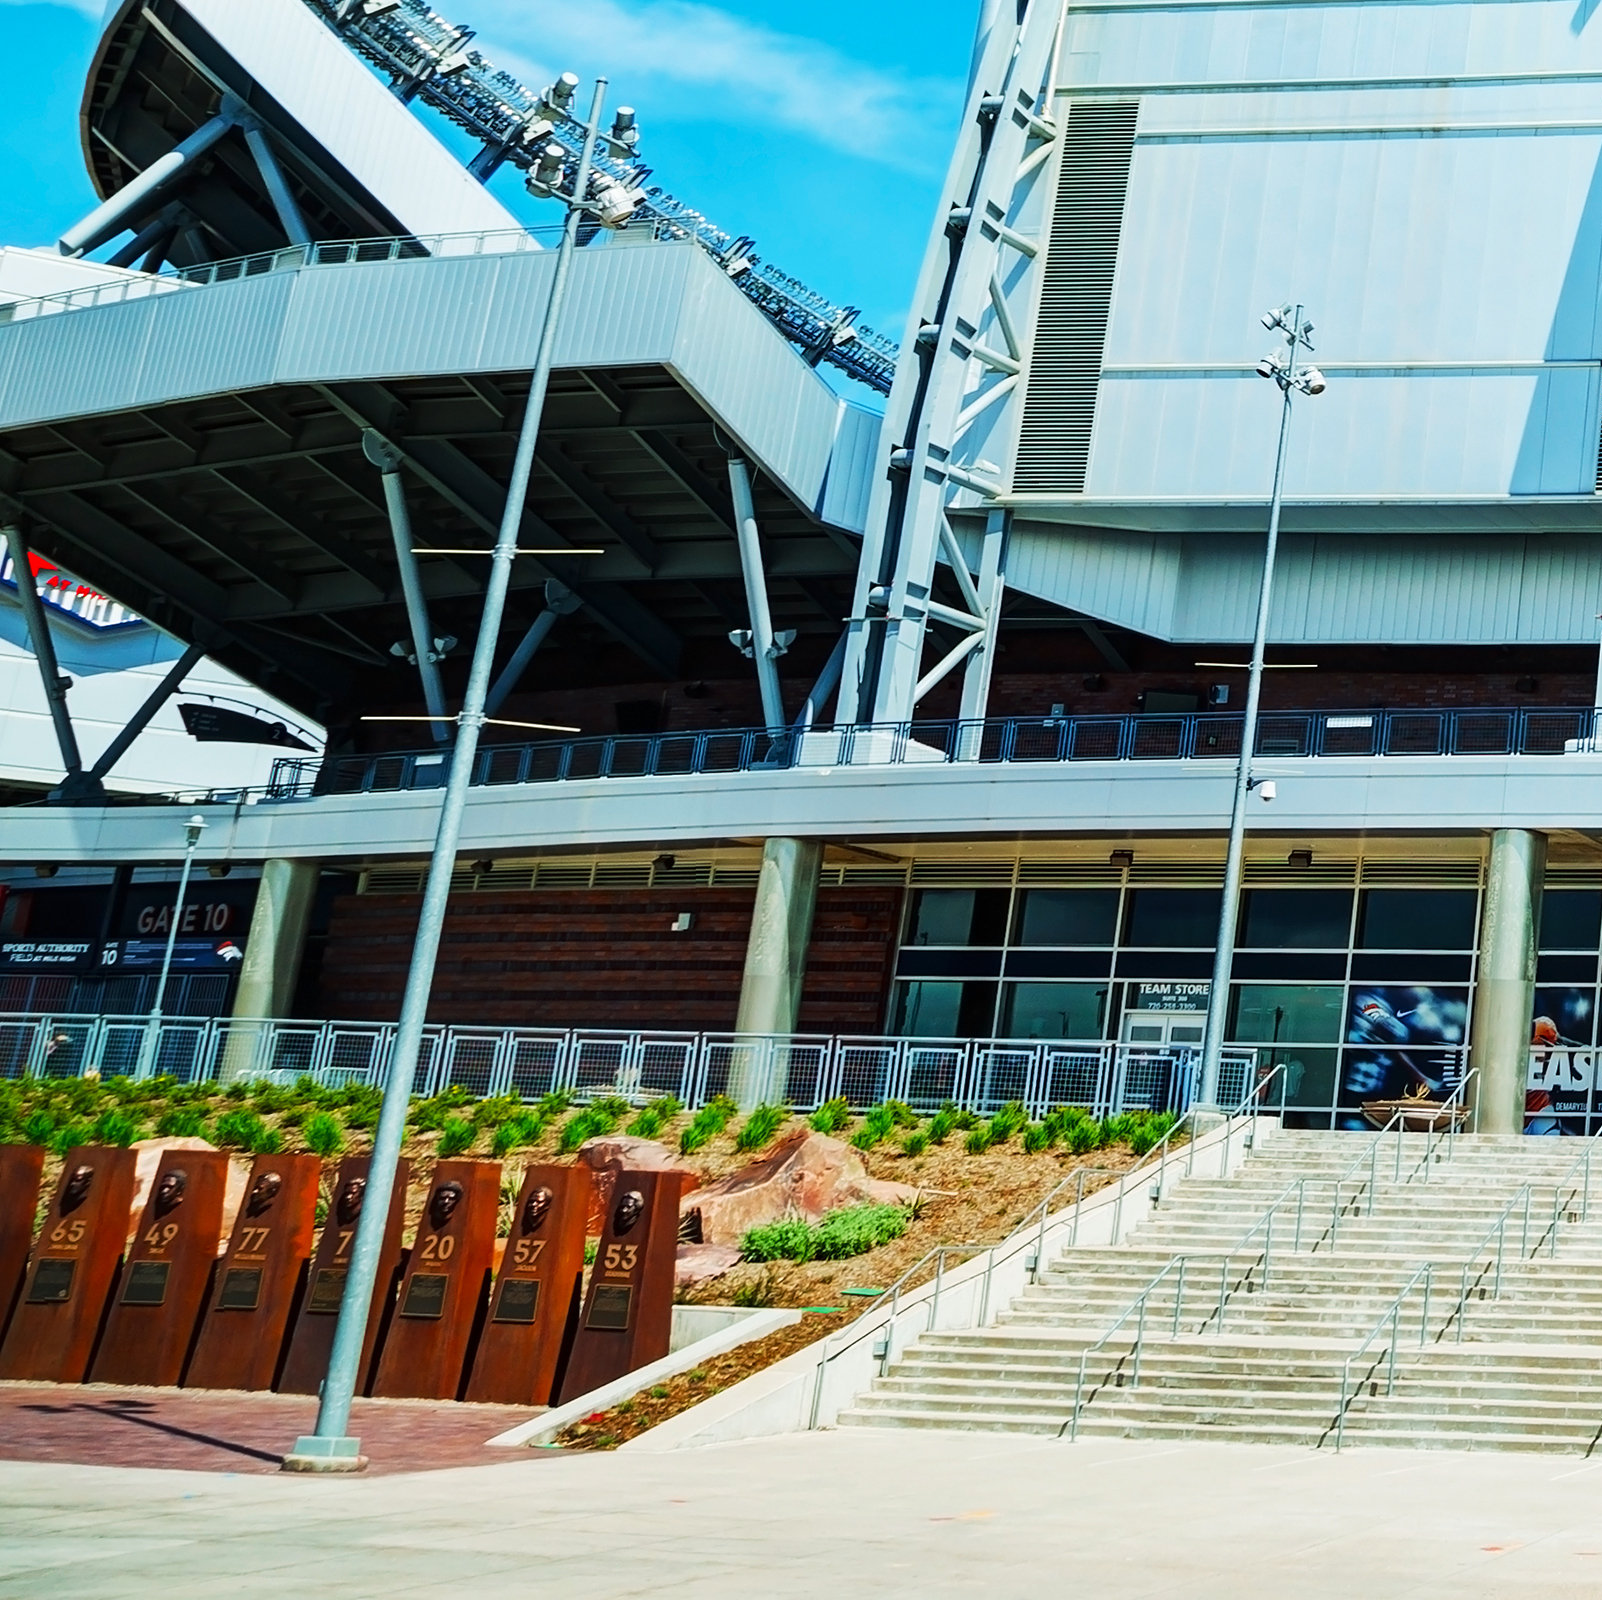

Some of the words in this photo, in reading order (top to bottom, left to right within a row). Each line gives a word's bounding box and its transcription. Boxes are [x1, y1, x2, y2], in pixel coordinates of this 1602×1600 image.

[46, 575, 72, 591] AT
[138, 904, 199, 934] GATE
[204, 903, 229, 932] 10
[101, 949, 118, 965] 10
[1139, 983, 1171, 994] TEAM
[1175, 984, 1210, 995] STORE
[50, 1219, 87, 1243] 65
[144, 1222, 179, 1246] 49
[237, 1227, 271, 1252] 77
[420, 1234, 455, 1260] 20
[513, 1239, 547, 1264] 57
[604, 1243, 639, 1270] 53
